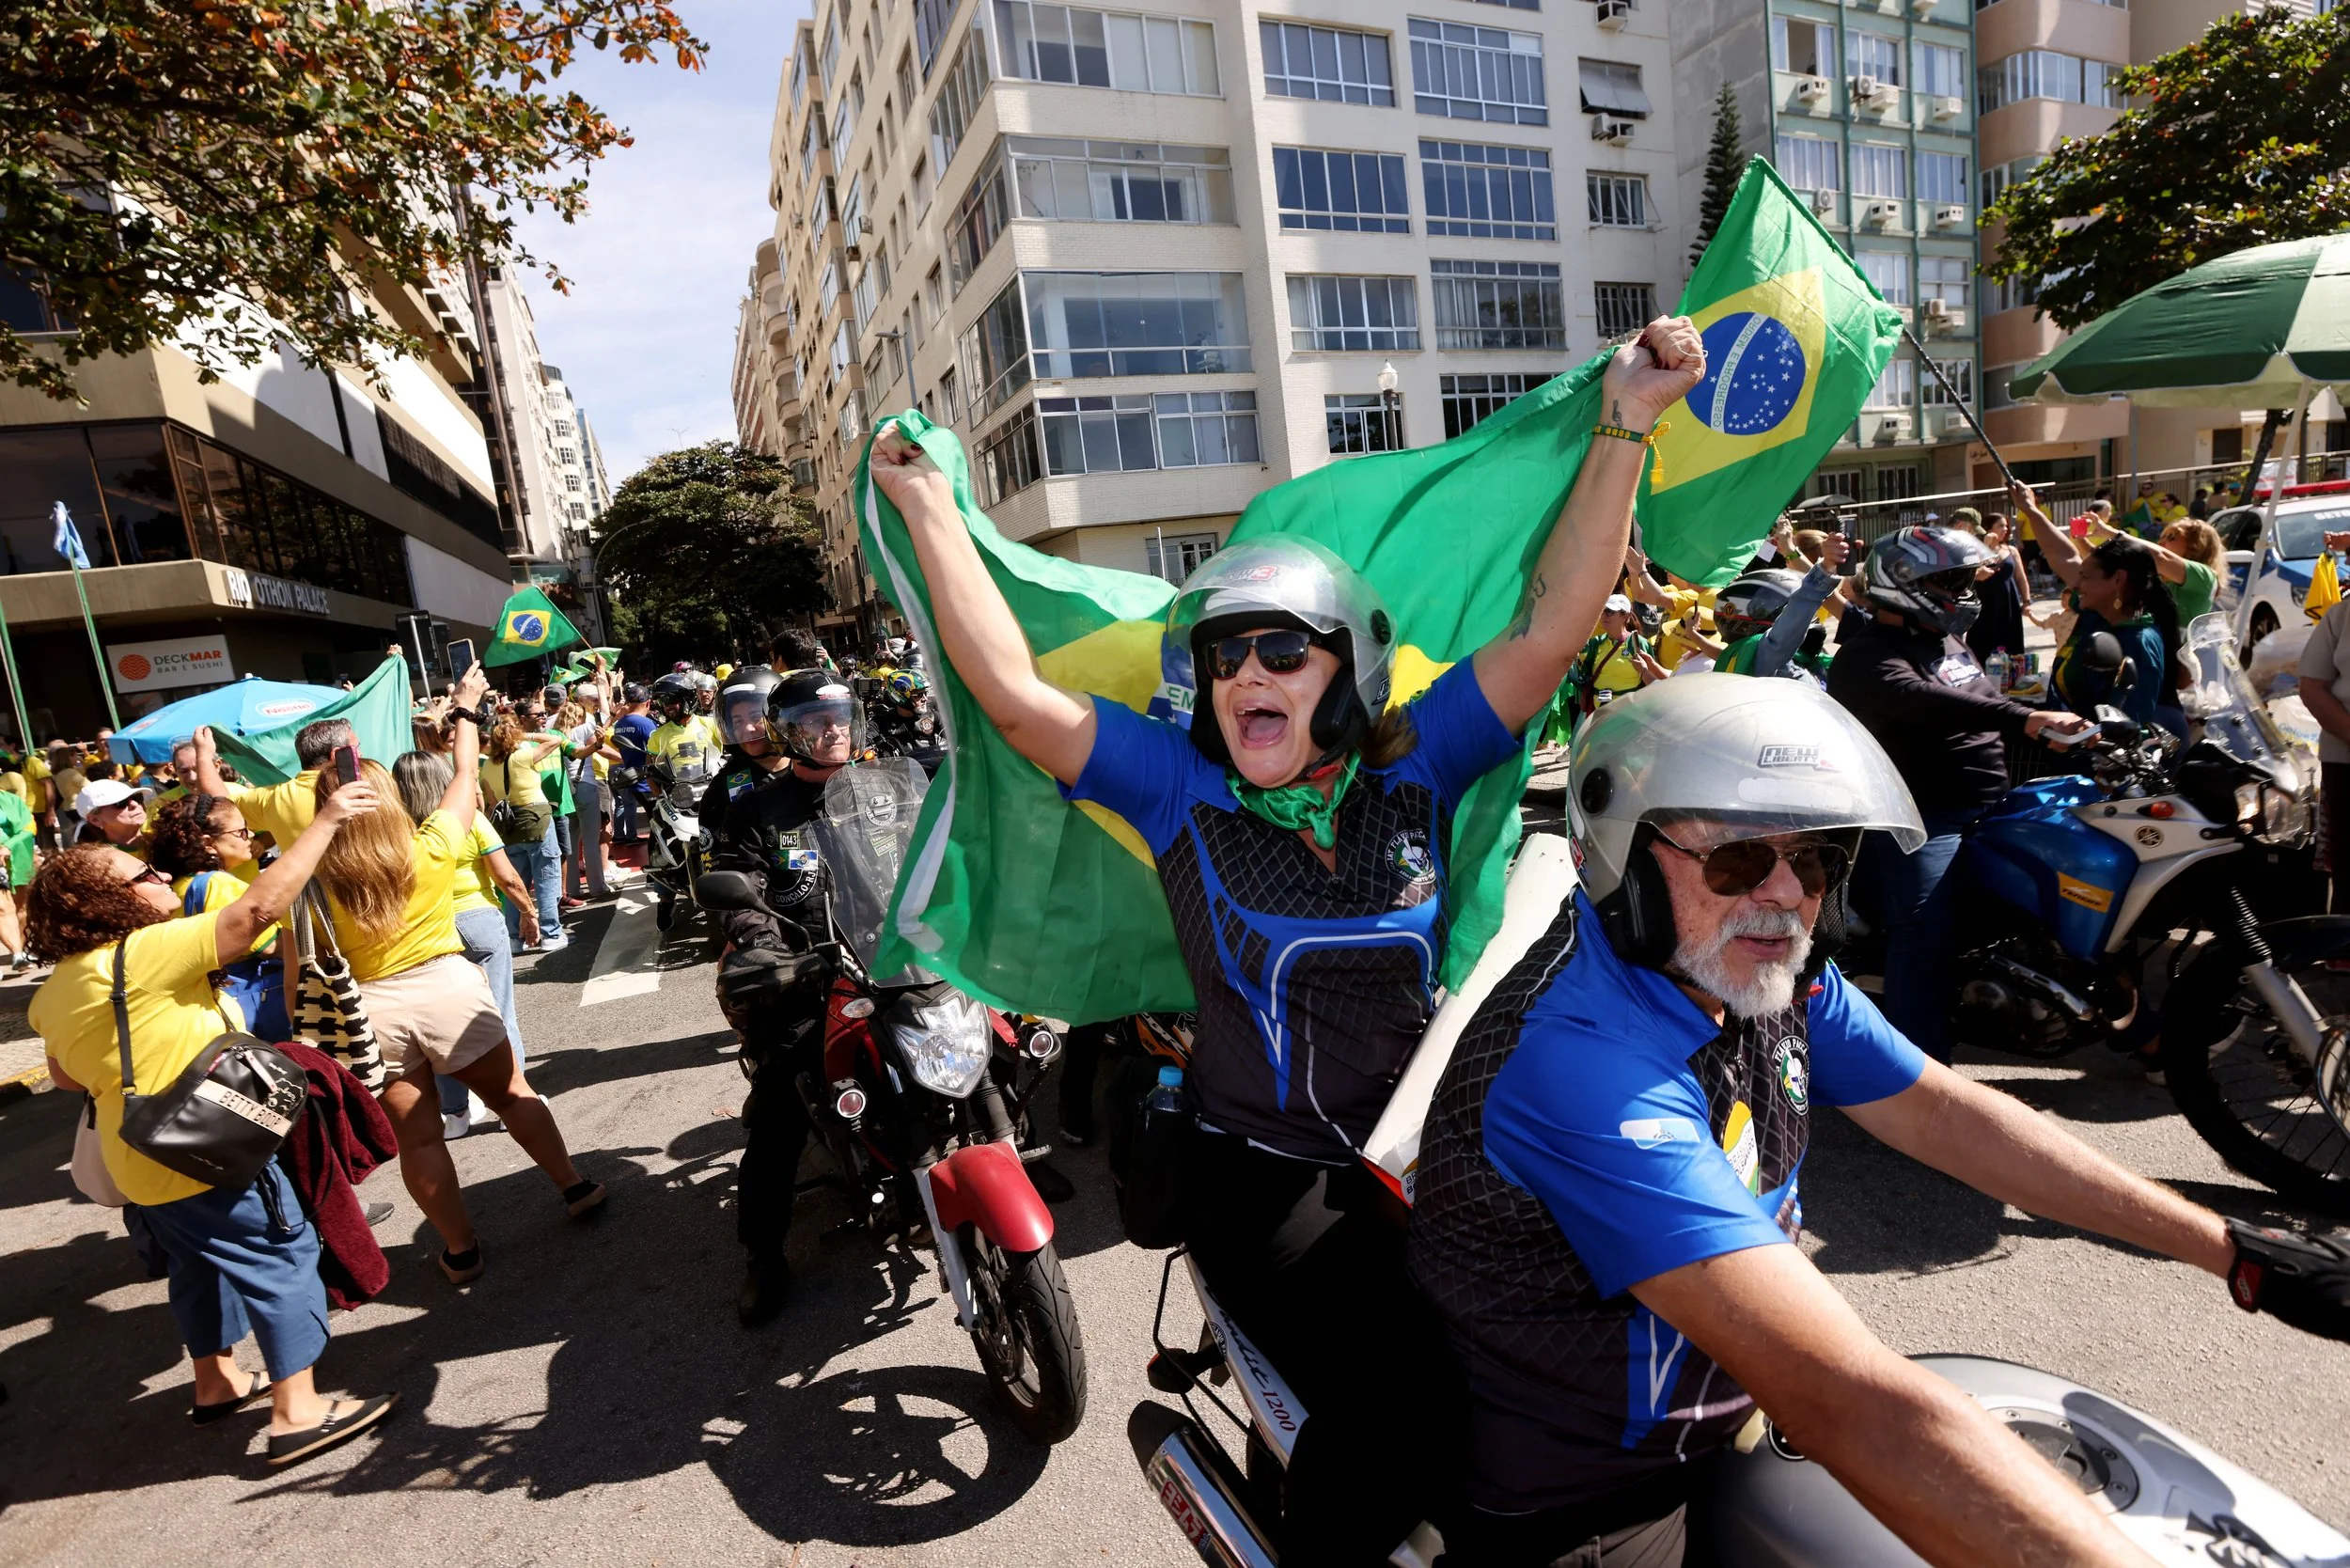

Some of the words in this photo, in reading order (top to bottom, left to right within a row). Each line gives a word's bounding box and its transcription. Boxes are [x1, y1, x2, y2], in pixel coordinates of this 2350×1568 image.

[227, 570, 252, 603] RIO
[254, 576, 293, 607] OTHON
[294, 586, 330, 614] PALACE
[154, 650, 222, 666] DECKMAR
[192, 661, 223, 670] SUSHI
[782, 835, 797, 846] 0143
[220, 1090, 257, 1117] BETTY
[254, 1108, 281, 1128] BOOP
[1261, 1389, 1296, 1432] 1200
